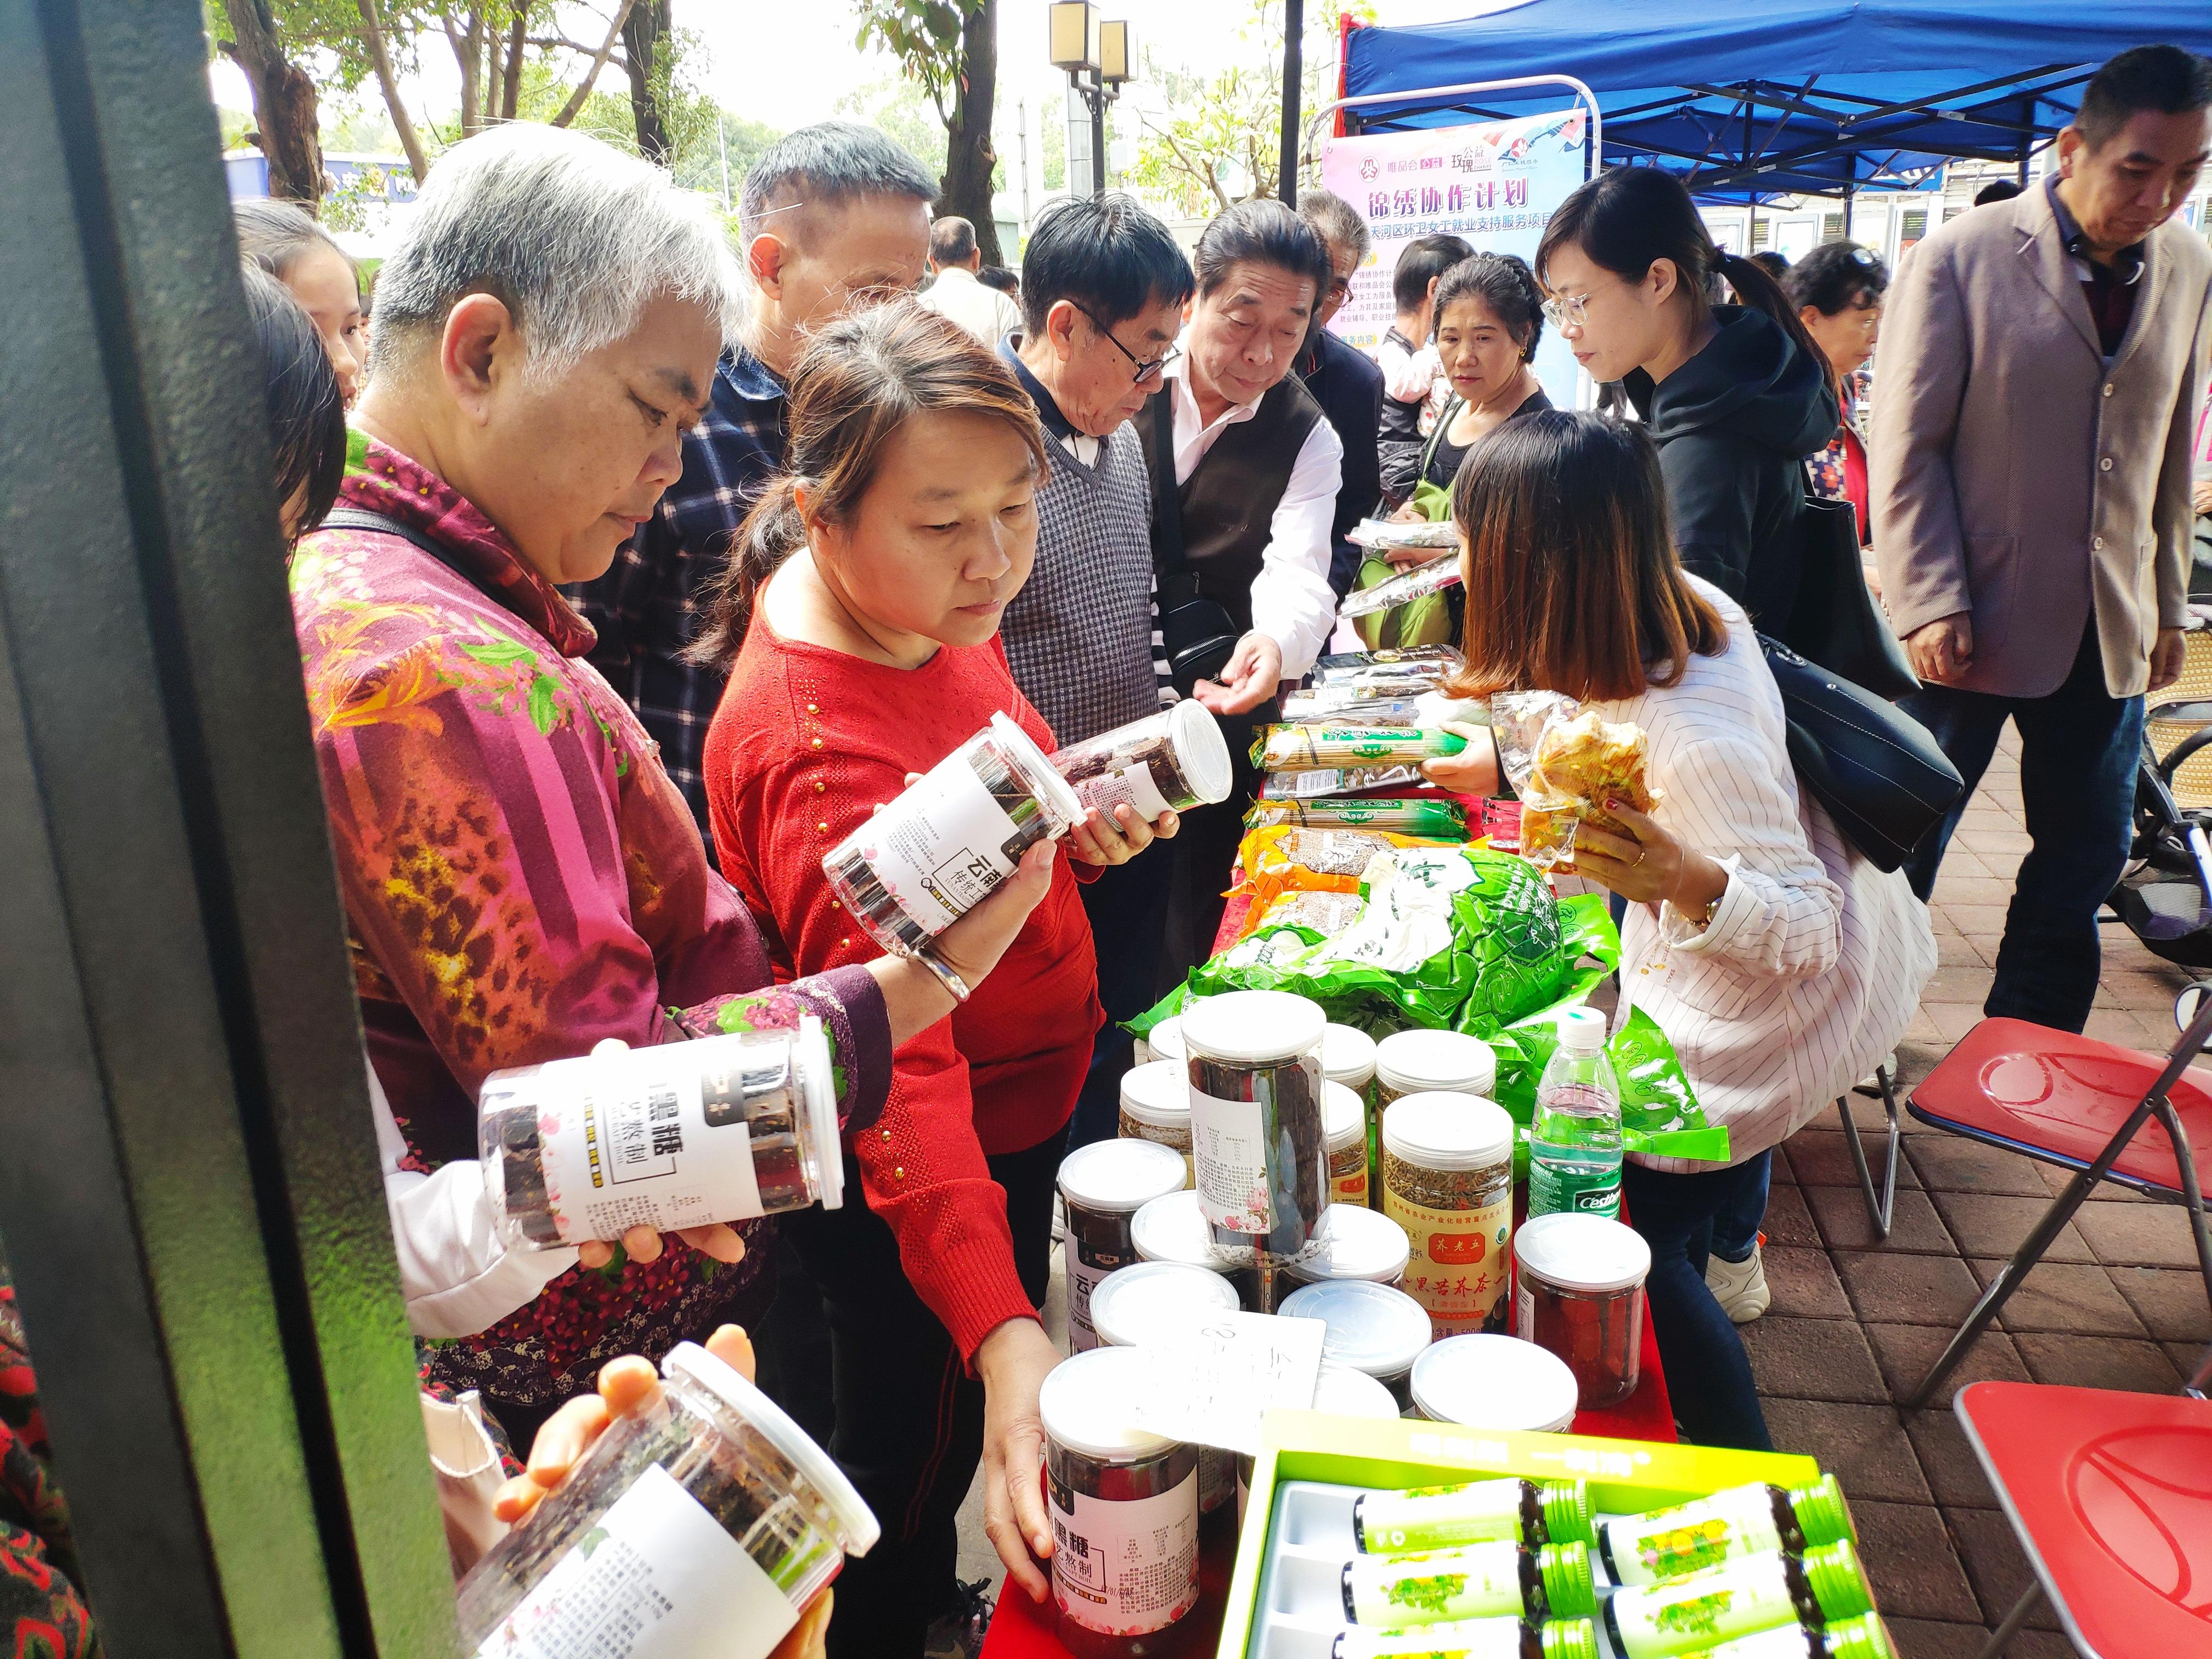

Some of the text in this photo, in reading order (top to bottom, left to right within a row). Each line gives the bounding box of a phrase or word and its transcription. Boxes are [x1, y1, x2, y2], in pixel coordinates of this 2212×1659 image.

[1387, 159, 1418, 173] 唯品会
[1368, 178, 1530, 219] 锦绣协作计划
[1370, 212, 1553, 239] 天河区环卫女工就业支持服务项目
[1076, 1273, 1097, 1295] 云
